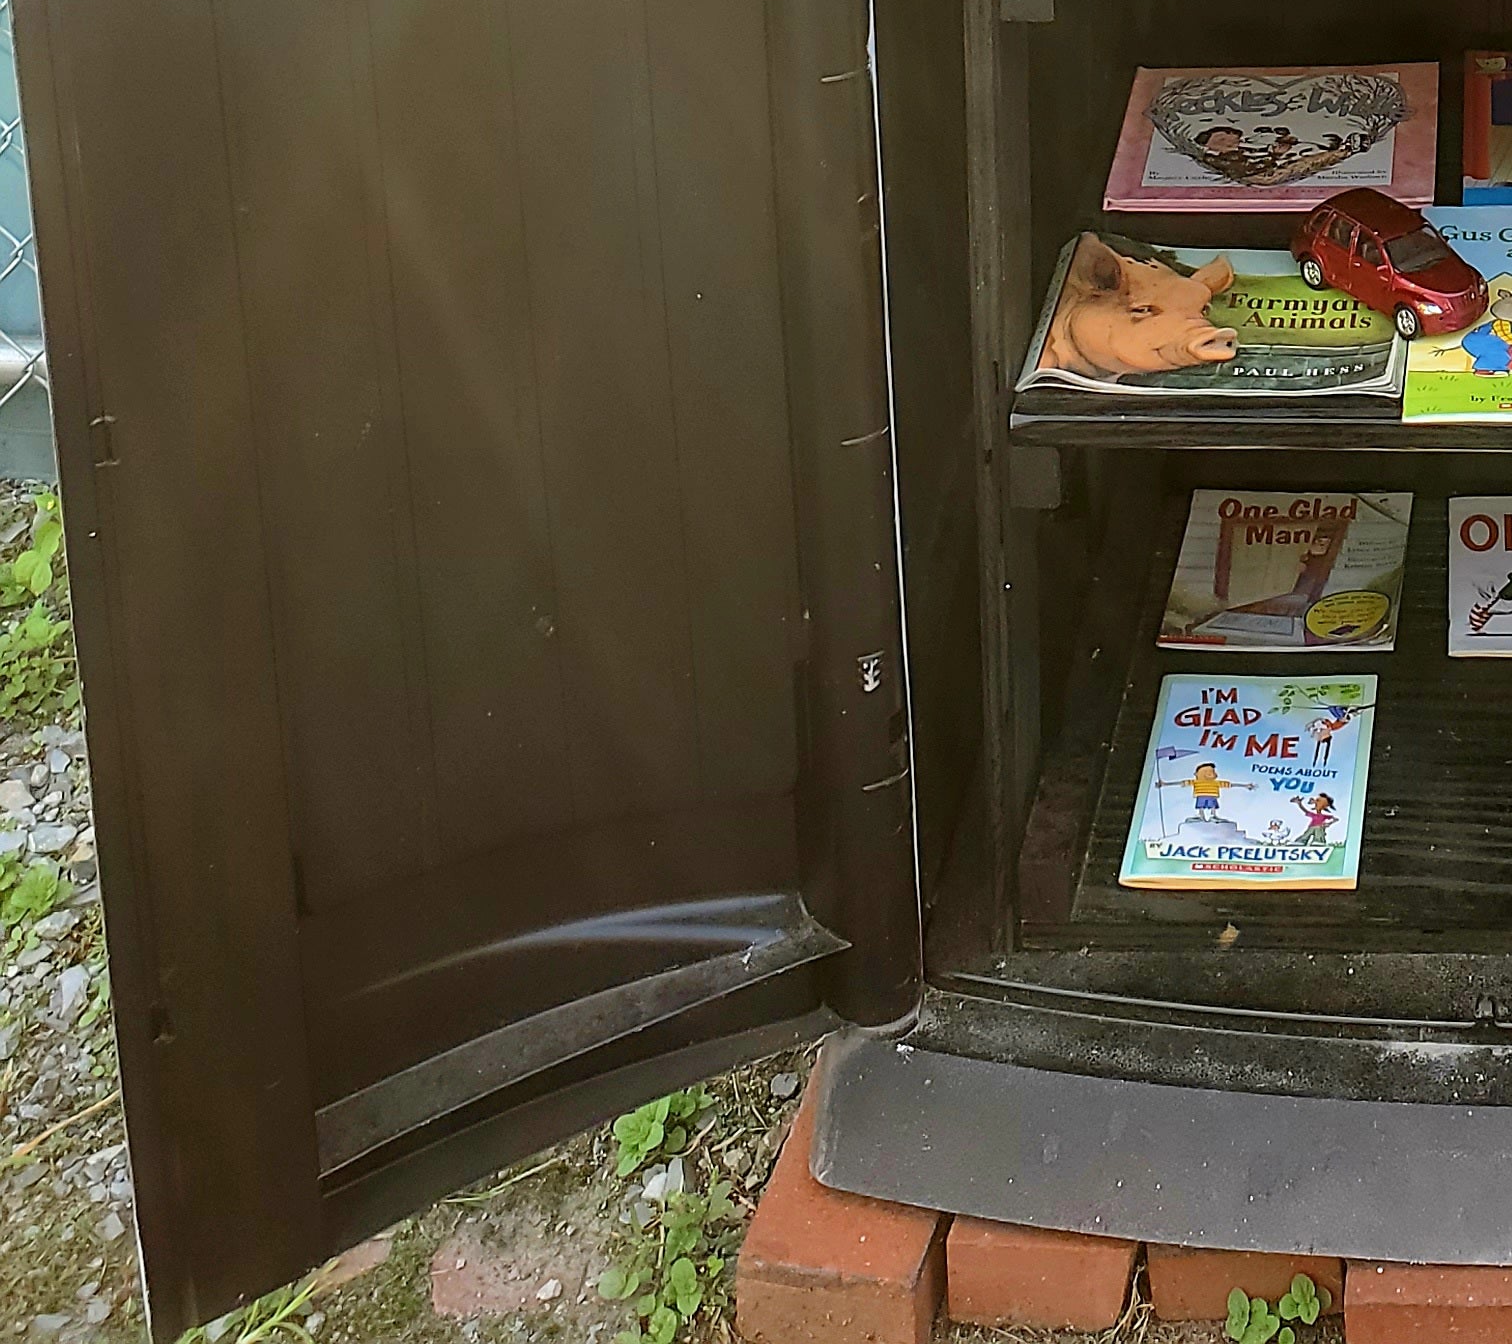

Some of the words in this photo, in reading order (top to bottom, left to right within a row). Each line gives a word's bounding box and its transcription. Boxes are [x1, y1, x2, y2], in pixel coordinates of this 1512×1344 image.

[1440, 225, 1492, 241] Gus
[1228, 293, 1375, 315] Farmyar
[1242, 312, 1372, 328] Animals
[1233, 367, 1294, 376] PAUL
[1218, 498, 1279, 520] One
[1289, 498, 1358, 520] Glad
[1246, 525, 1311, 545] Man
[1201, 688, 1237, 704] I'M
[1174, 706, 1262, 727] GLAD
[1198, 729, 1238, 750] I'M
[1244, 733, 1299, 758] ME
[1251, 764, 1292, 776] POEMS
[1295, 768, 1338, 779] ABOUT
[1269, 777, 1314, 793] YOU
[1160, 843, 1209, 858] JACK
[1217, 846, 1330, 861] PRELUTSKY
